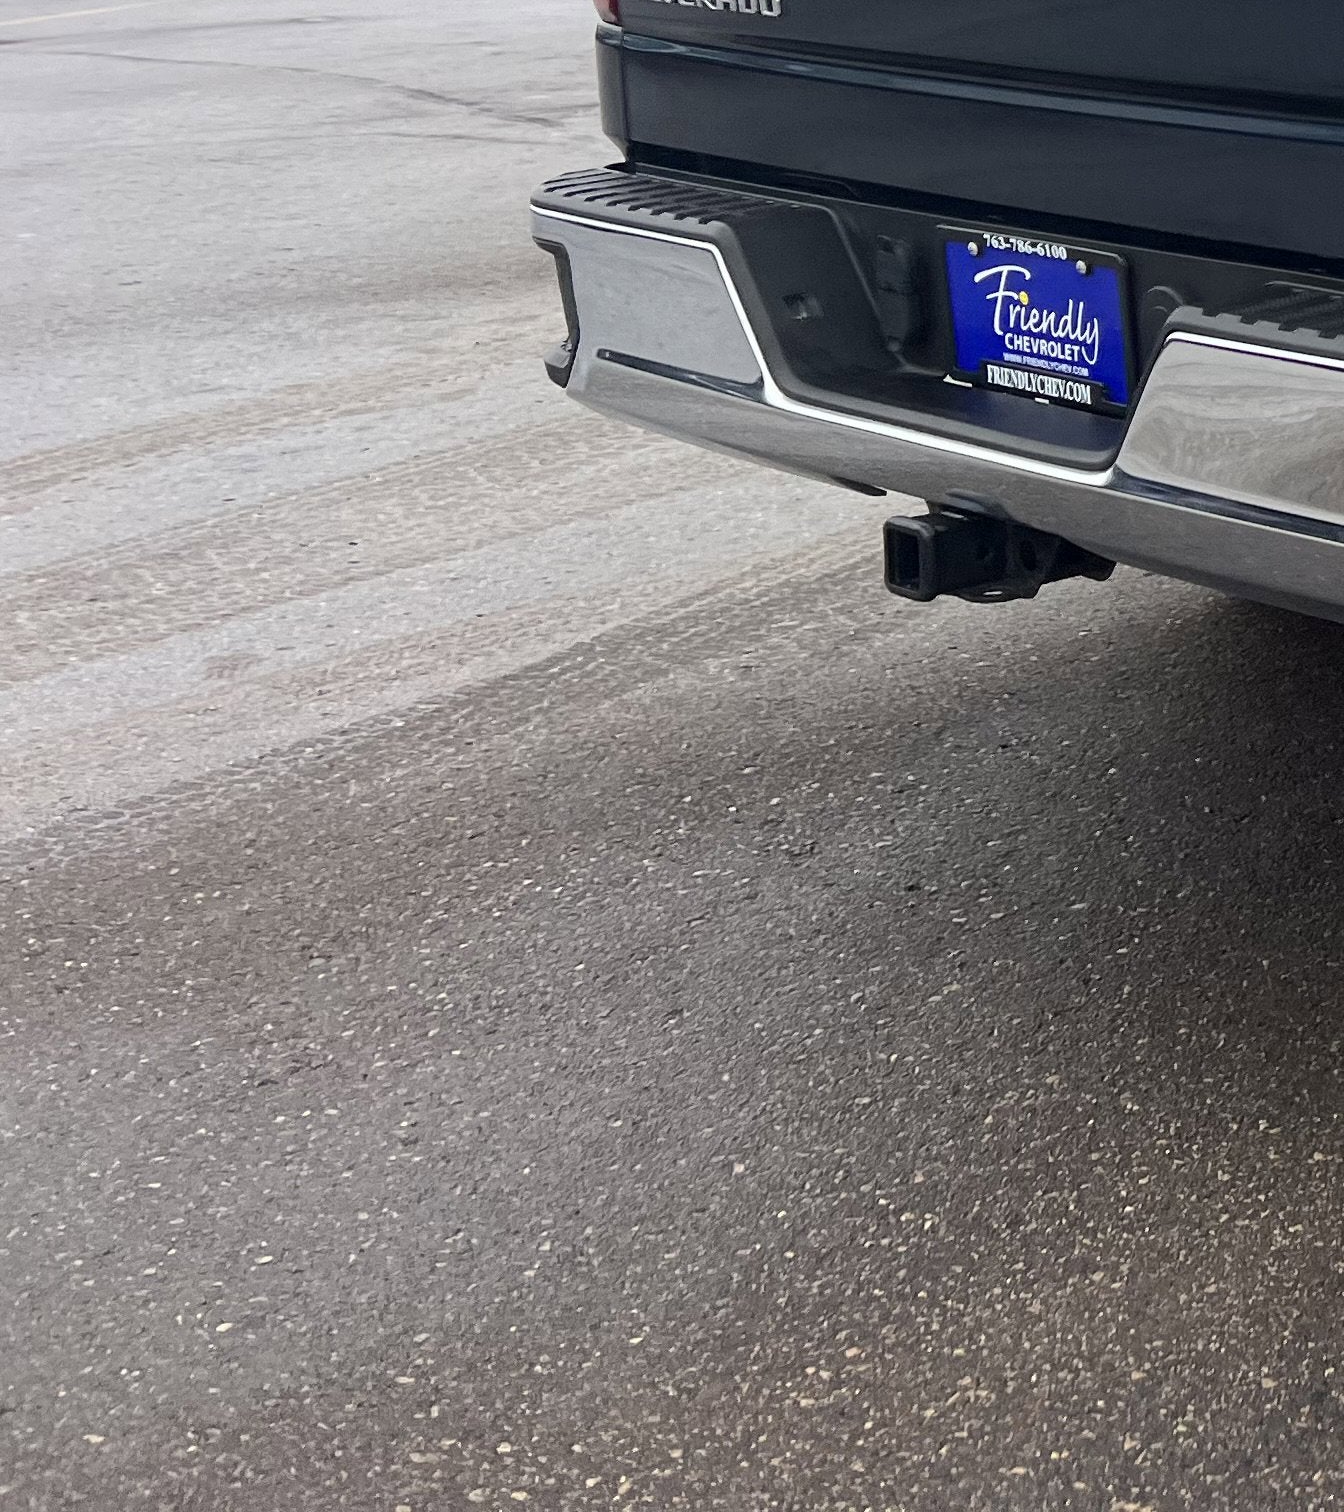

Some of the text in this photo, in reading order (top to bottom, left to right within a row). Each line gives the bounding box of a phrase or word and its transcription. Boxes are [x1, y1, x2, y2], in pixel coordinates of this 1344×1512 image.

[983, 234, 1067, 260] 763-786-6100
[974, 264, 1099, 365] Friendly
[1004, 334, 1080, 362] CHEVROLET
[988, 365, 1091, 404] FRIENDLYCHEV.COM
